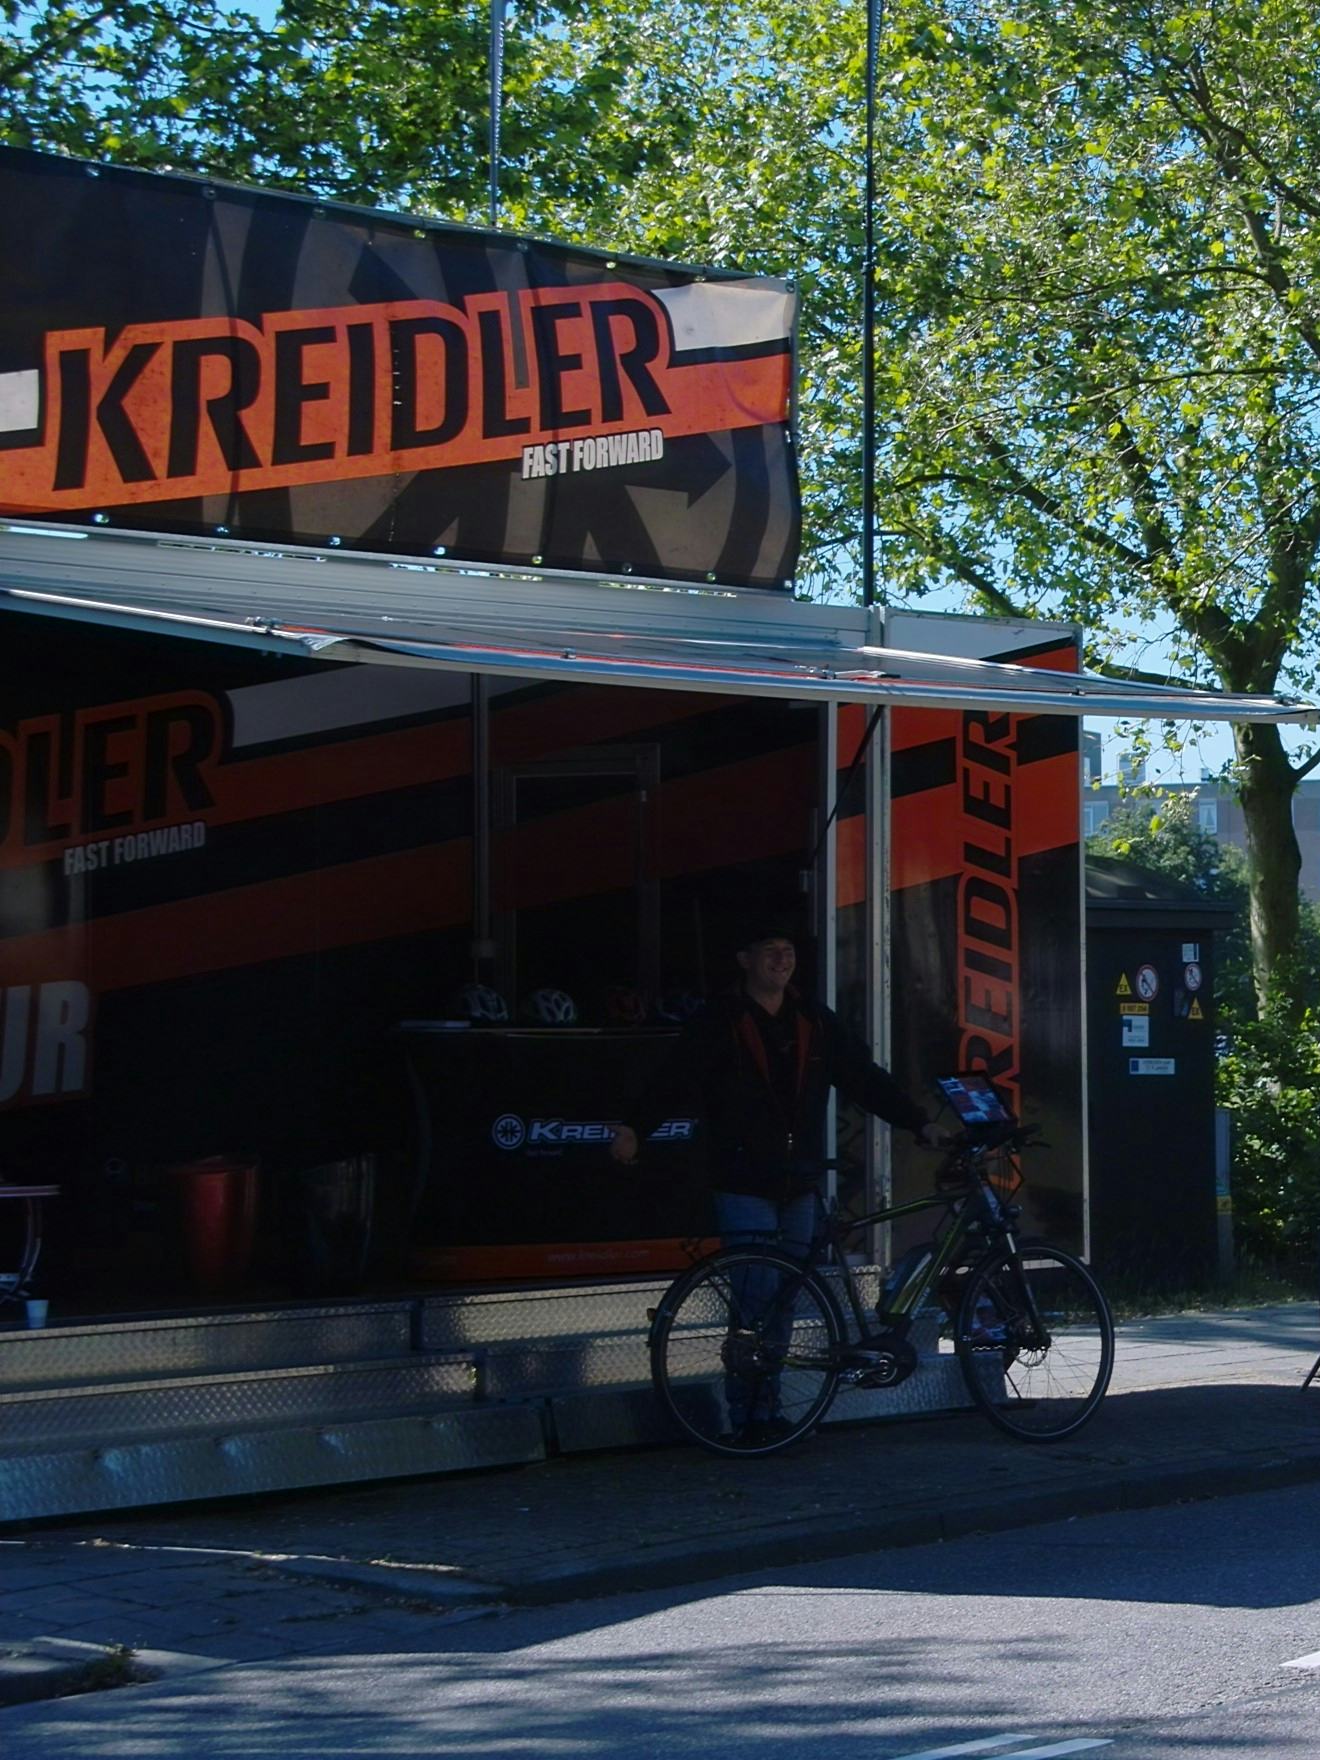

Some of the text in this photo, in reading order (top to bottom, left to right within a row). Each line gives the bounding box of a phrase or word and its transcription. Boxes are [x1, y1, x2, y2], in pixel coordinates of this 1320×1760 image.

[51, 296, 673, 492] KREIDLER
[521, 429, 665, 480] FAST FORWARD
[0, 703, 217, 848] LER
[63, 820, 207, 877] FAST FORWARD
[961, 711, 1015, 1108] REIDLER
[529, 1120, 692, 1140] KREIER
